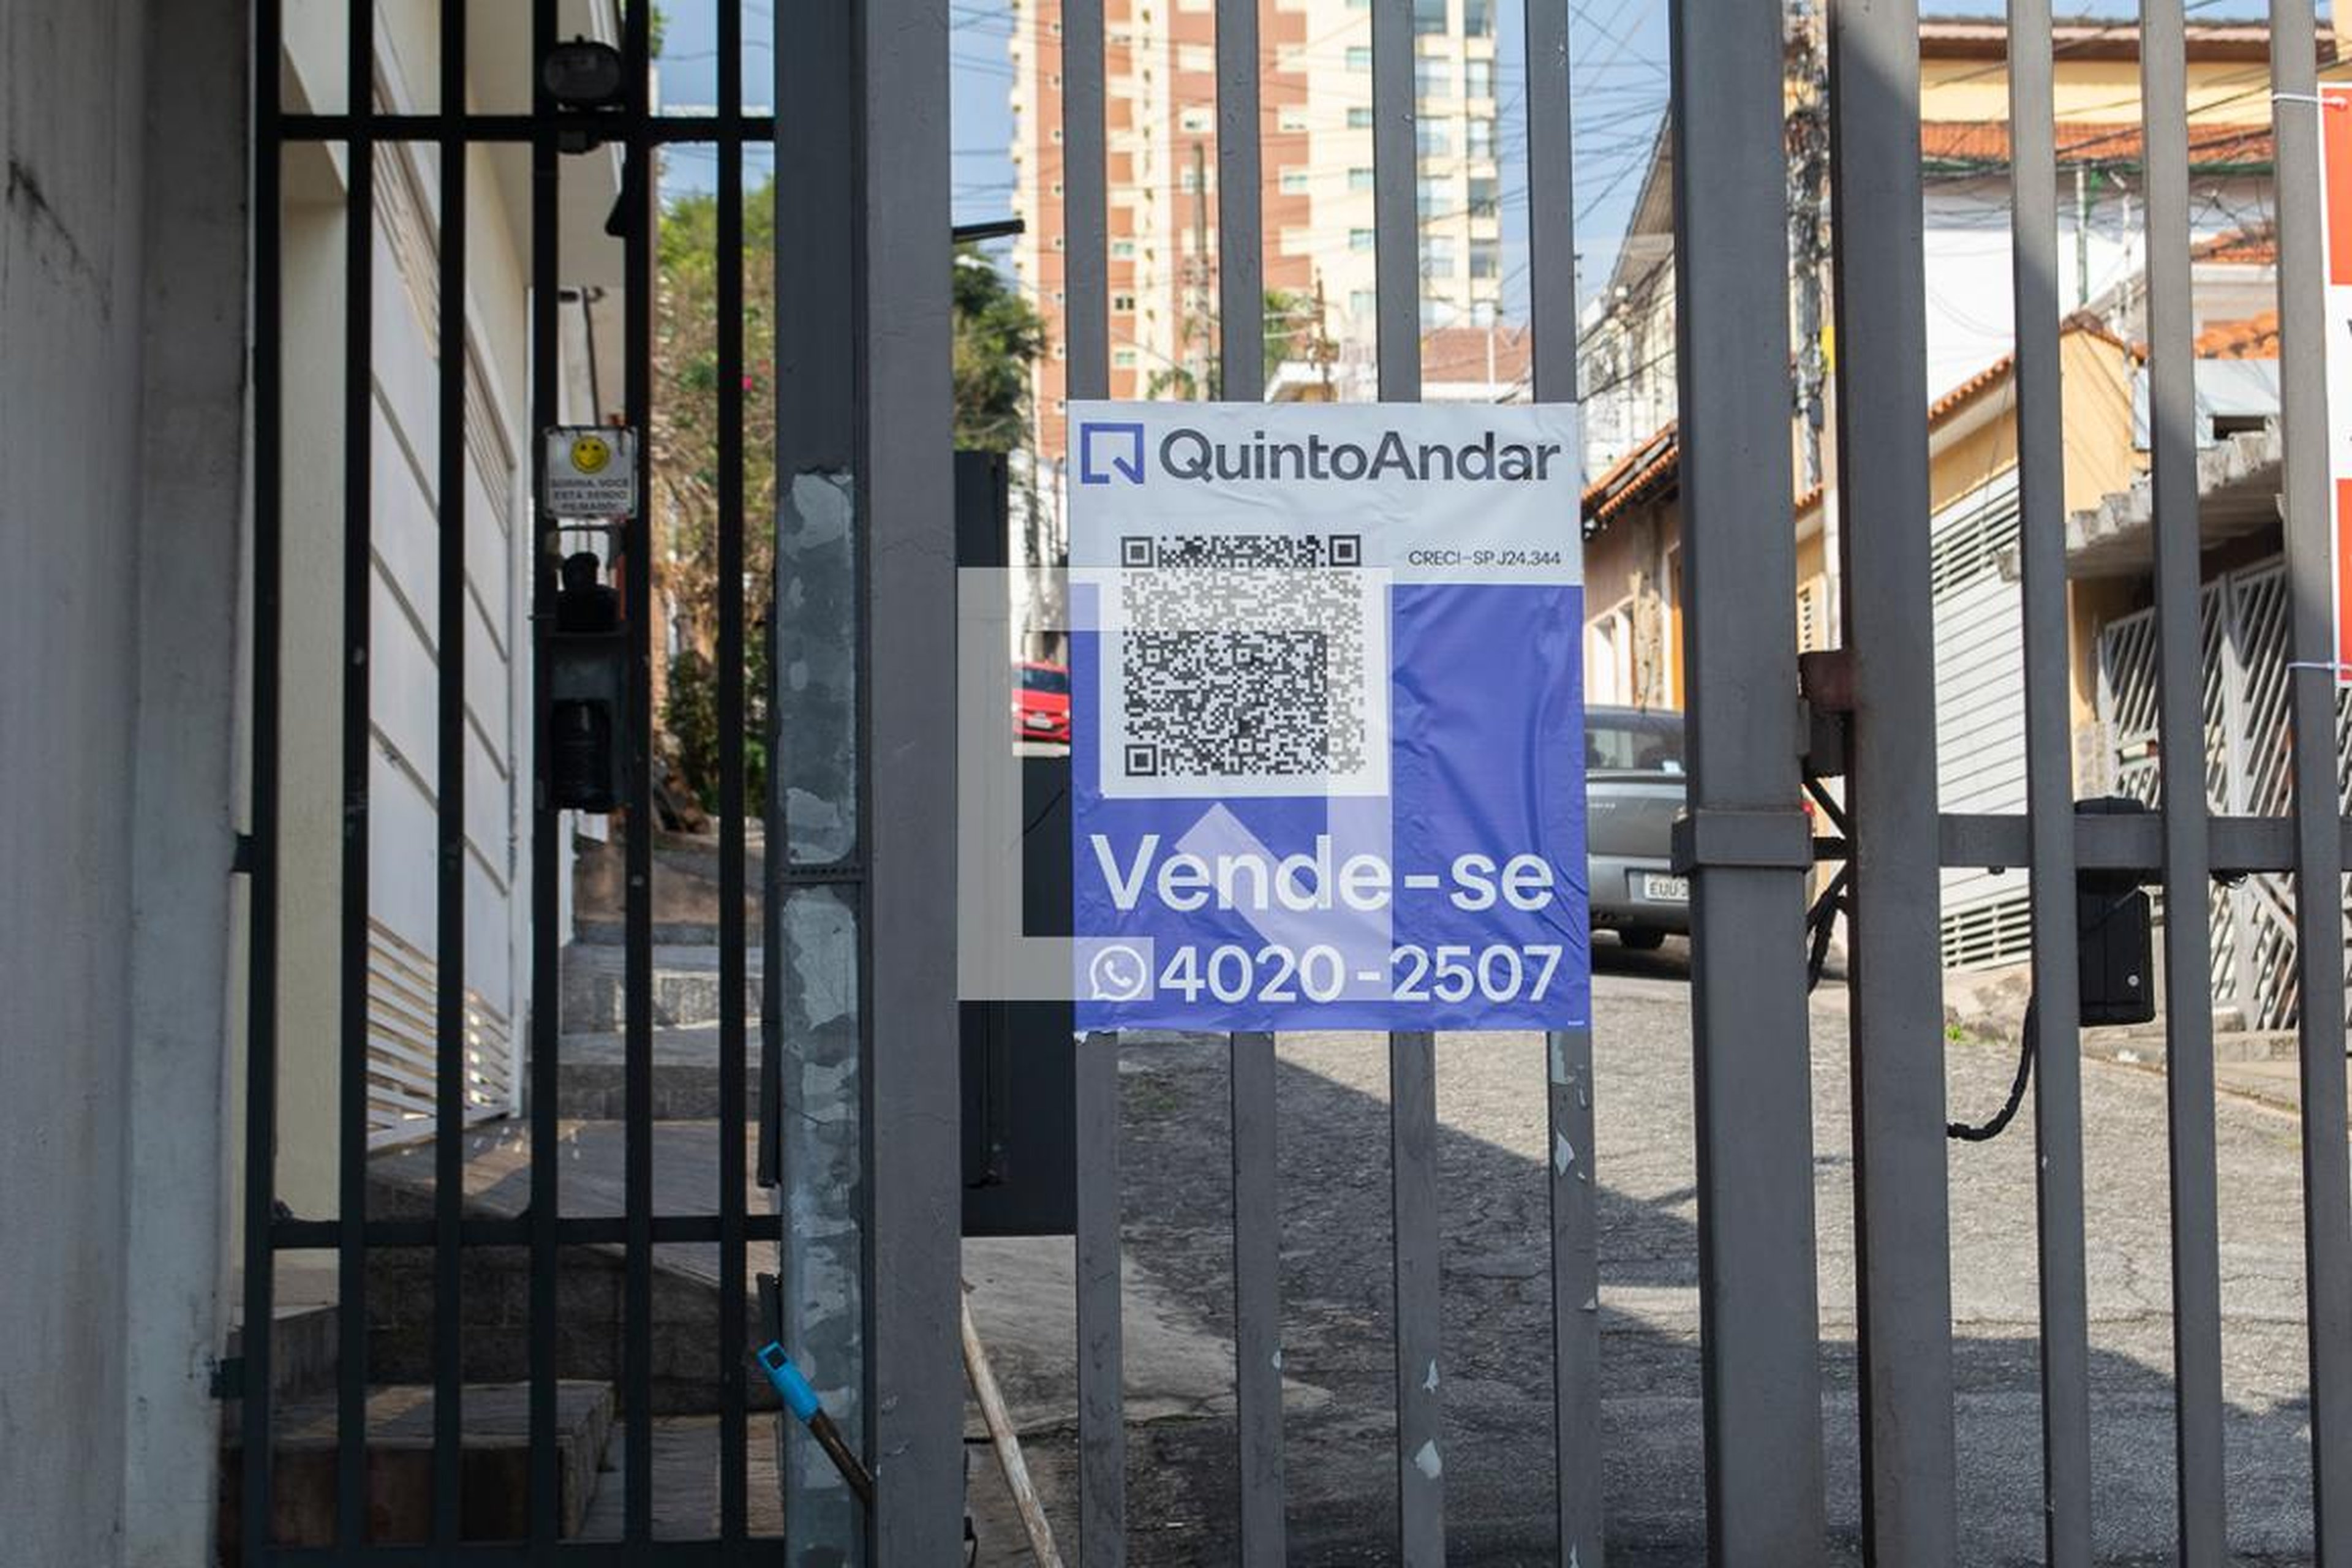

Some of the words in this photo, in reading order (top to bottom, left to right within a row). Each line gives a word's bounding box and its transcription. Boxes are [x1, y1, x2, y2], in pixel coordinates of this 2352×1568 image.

[1159, 428, 1561, 483] QuintoAndar
[1409, 551, 1494, 566] CRECI-SP
[1090, 834, 1554, 911] Vende-se
[1159, 944, 1562, 1003] 4020-2507
